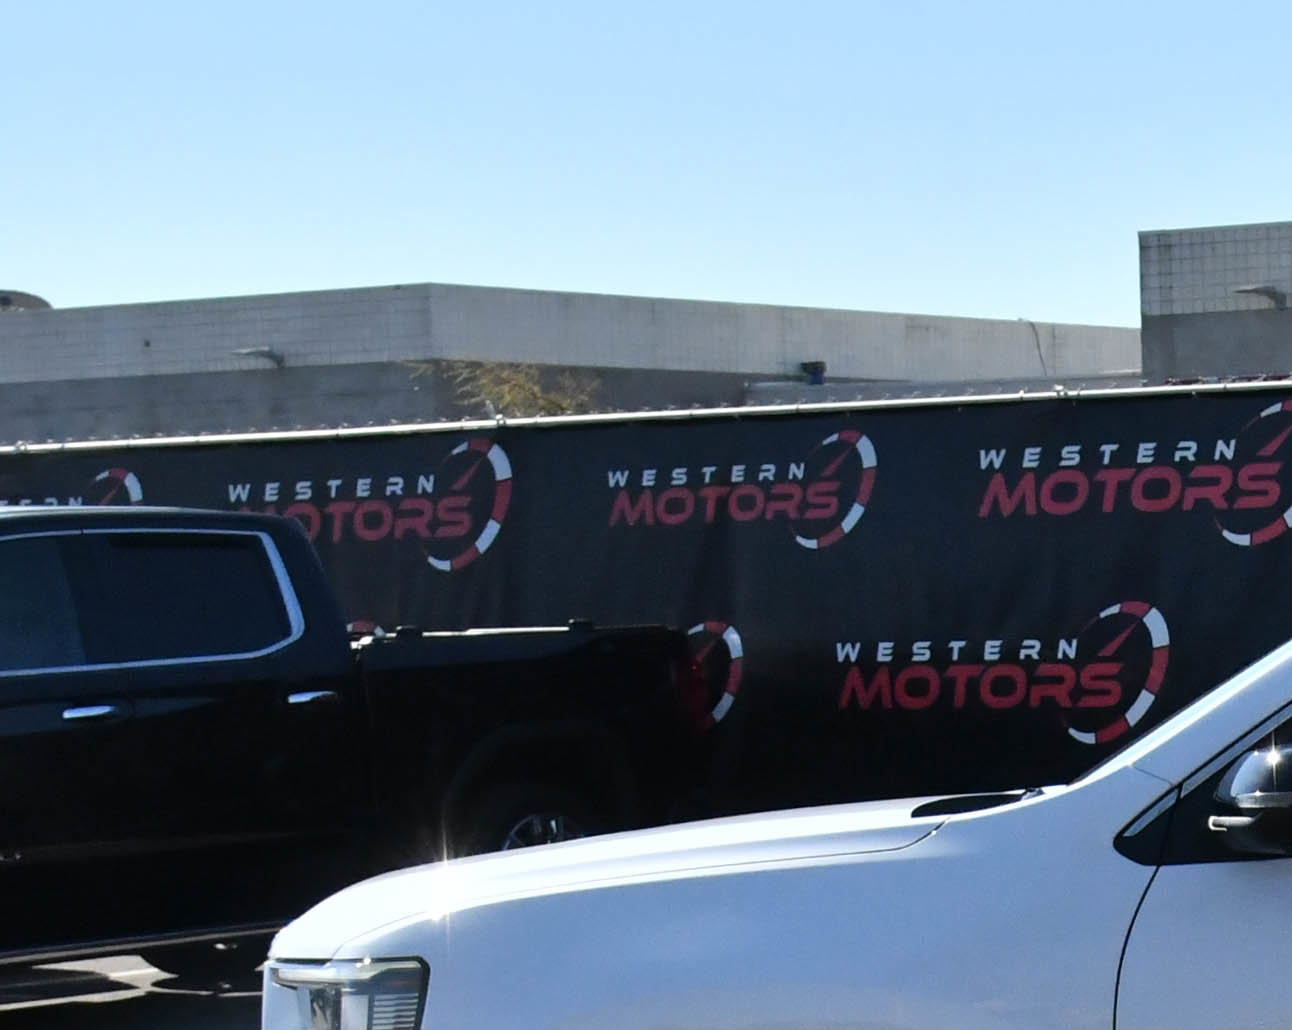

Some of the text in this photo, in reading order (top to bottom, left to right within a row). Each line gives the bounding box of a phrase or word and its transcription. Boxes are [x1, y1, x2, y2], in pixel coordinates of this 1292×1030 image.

[979, 439, 1237, 470] WESTERN
[228, 475, 434, 503] WESTERN
[608, 463, 805, 488] WESTERN
[978, 461, 1283, 518] MOTORS
[239, 496, 472, 544] OTORS
[609, 481, 841, 527] MOTORS
[836, 638, 1078, 663] WESTERN
[839, 662, 1123, 709] MOTORS
